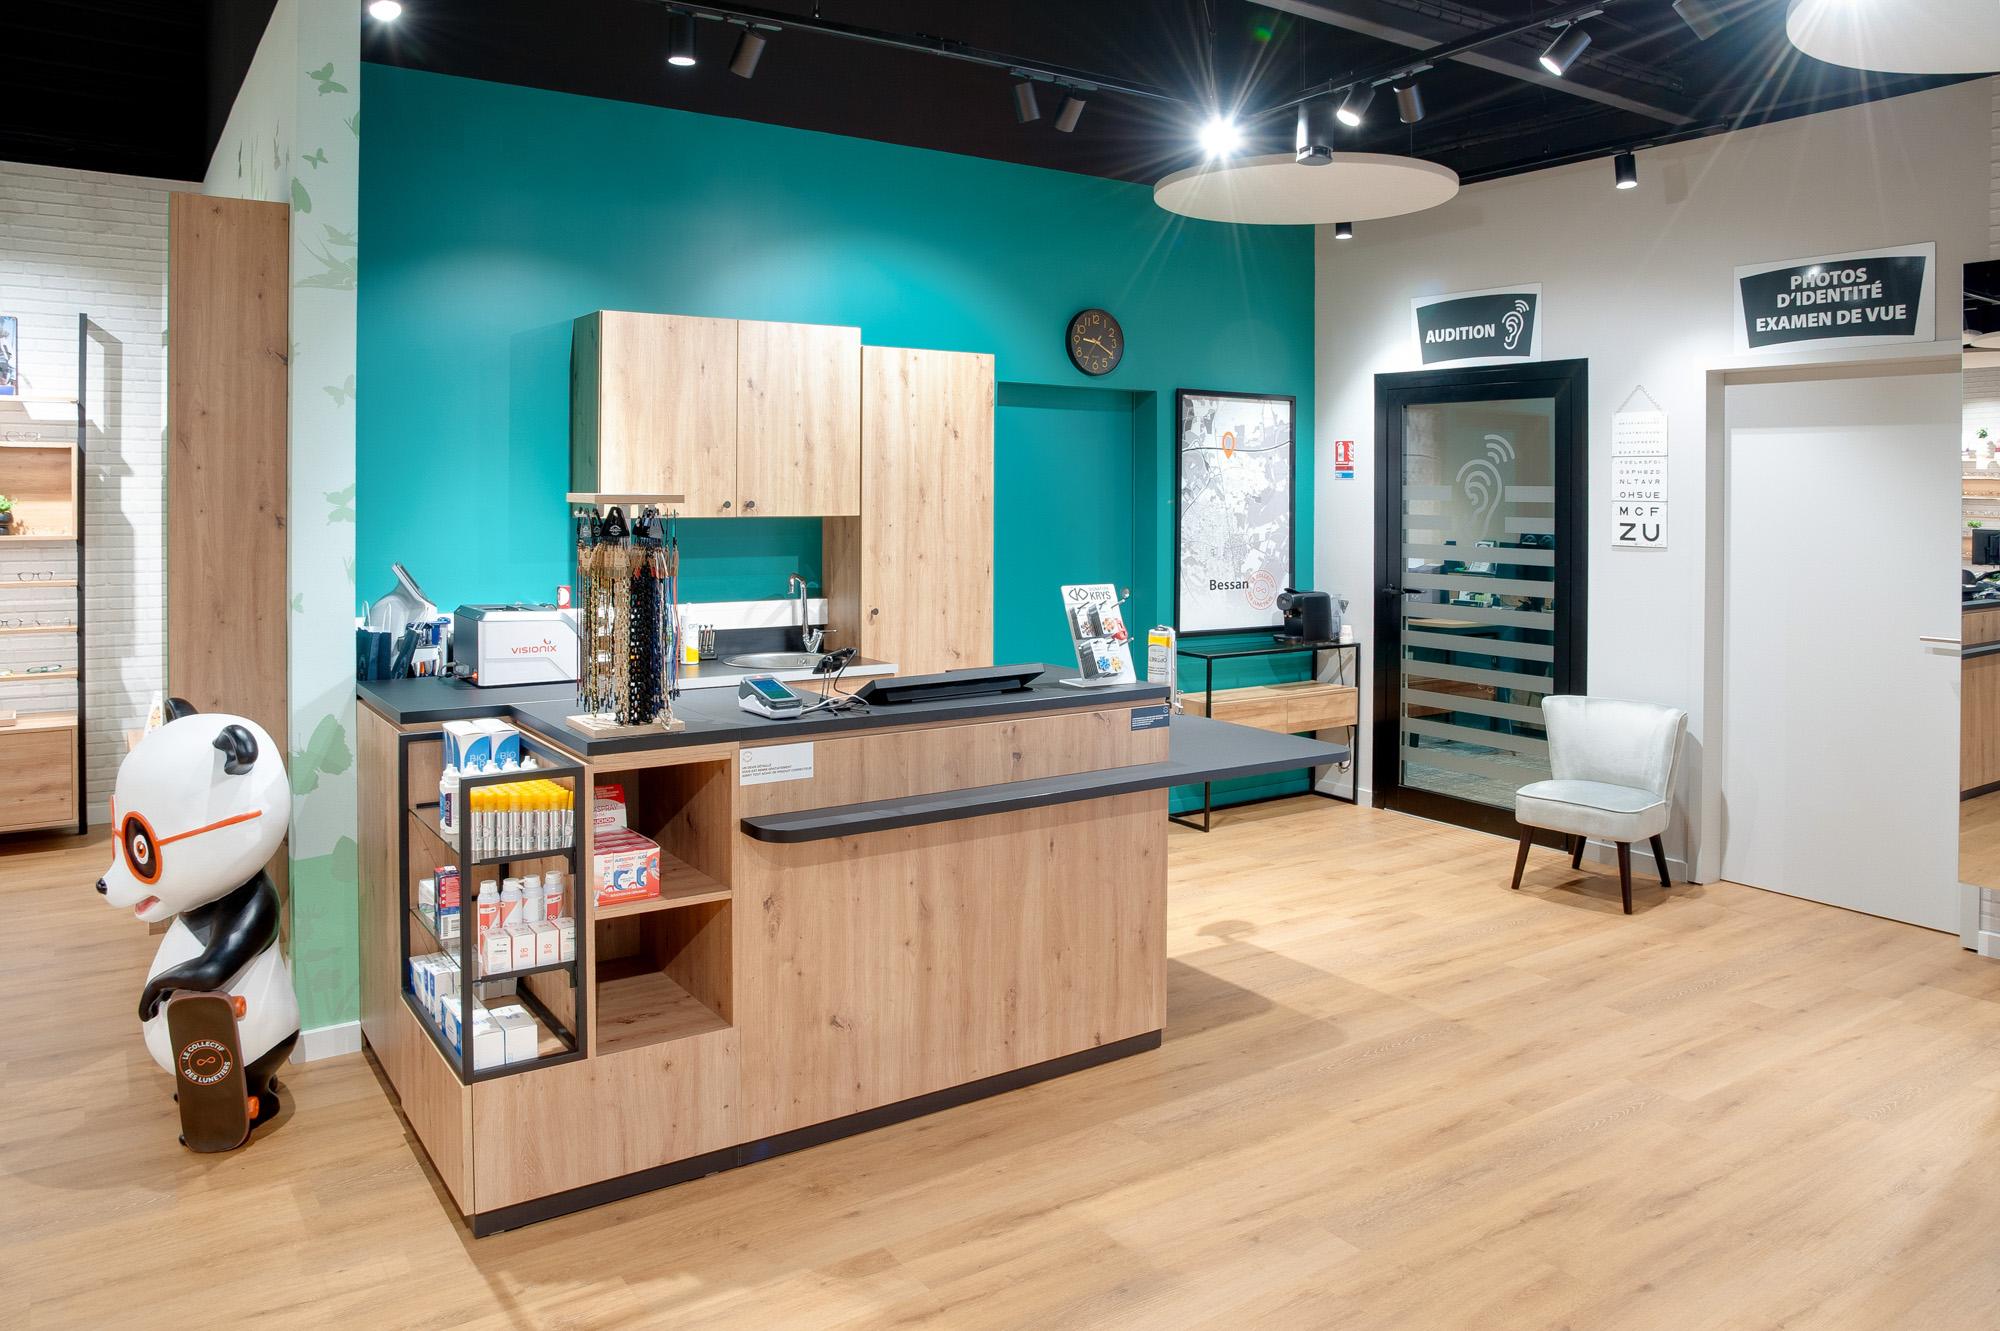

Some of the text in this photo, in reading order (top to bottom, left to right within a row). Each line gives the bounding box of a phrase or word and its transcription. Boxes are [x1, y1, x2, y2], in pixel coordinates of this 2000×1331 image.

[1790, 267, 1867, 290] PHOTOS
[1777, 280, 1882, 308] D'IDENTITÉ
[1084, 317, 1091, 327] 11
[1092, 314, 1100, 325] 12
[1756, 304, 1906, 332] EXAMEN DE VUE
[1103, 319, 1107, 329] 1
[1077, 325, 1086, 335] 10
[1108, 328, 1115, 338] 2
[1425, 323, 1496, 344] AUDITION
[1073, 334, 1080, 345] 9
[1112, 338, 1117, 349] 3
[1076, 346, 1083, 358] 8
[1083, 355, 1089, 366] 7
[1092, 360, 1099, 370] 6
[1102, 358, 1108, 368] 5
[1209, 579, 1249, 591] Bessan
[1089, 591, 1112, 601] KRYS
[182, 1041, 225, 1060] LE COLLECTIF
[184, 1068, 198, 1081] DES
